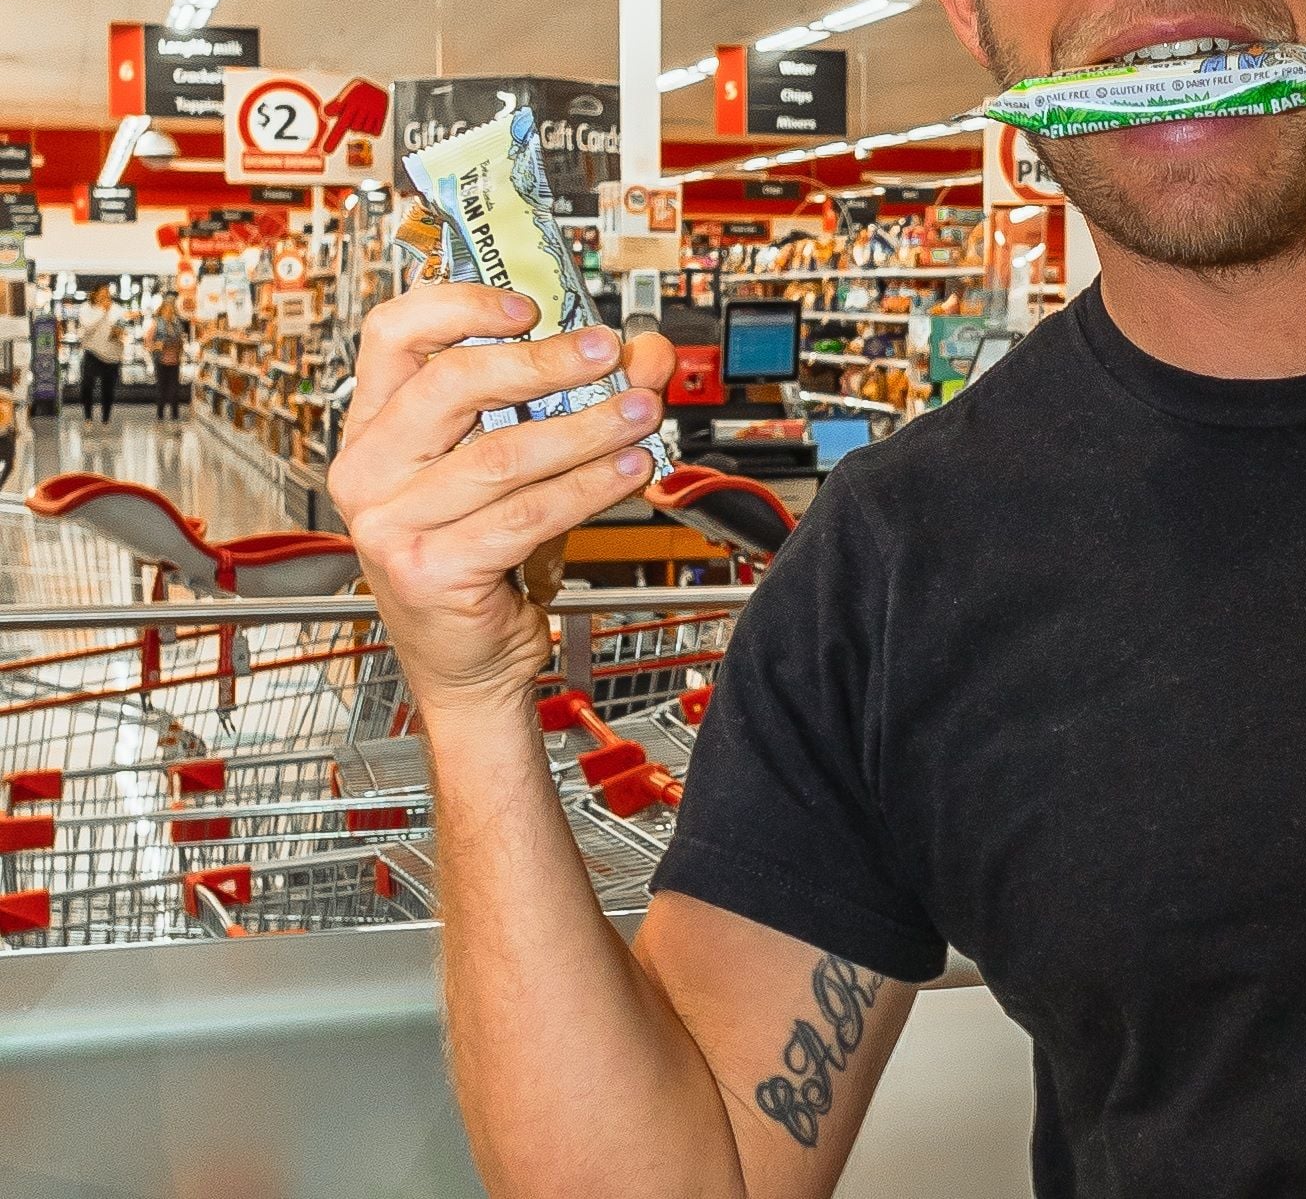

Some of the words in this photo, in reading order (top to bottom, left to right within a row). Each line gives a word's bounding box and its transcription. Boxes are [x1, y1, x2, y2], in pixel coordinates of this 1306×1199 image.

[1069, 90, 1091, 101] FREE
[1109, 85, 1144, 97] GLUTEN
[1144, 82, 1167, 93] FREE
[1211, 74, 1234, 85] FREE
[256, 102, 302, 140] $2
[1039, 119, 1121, 141] DELICIOUS
[1270, 92, 1306, 115] BAR
[575, 121, 621, 154] Card
[471, 222, 515, 291] PROTEI
